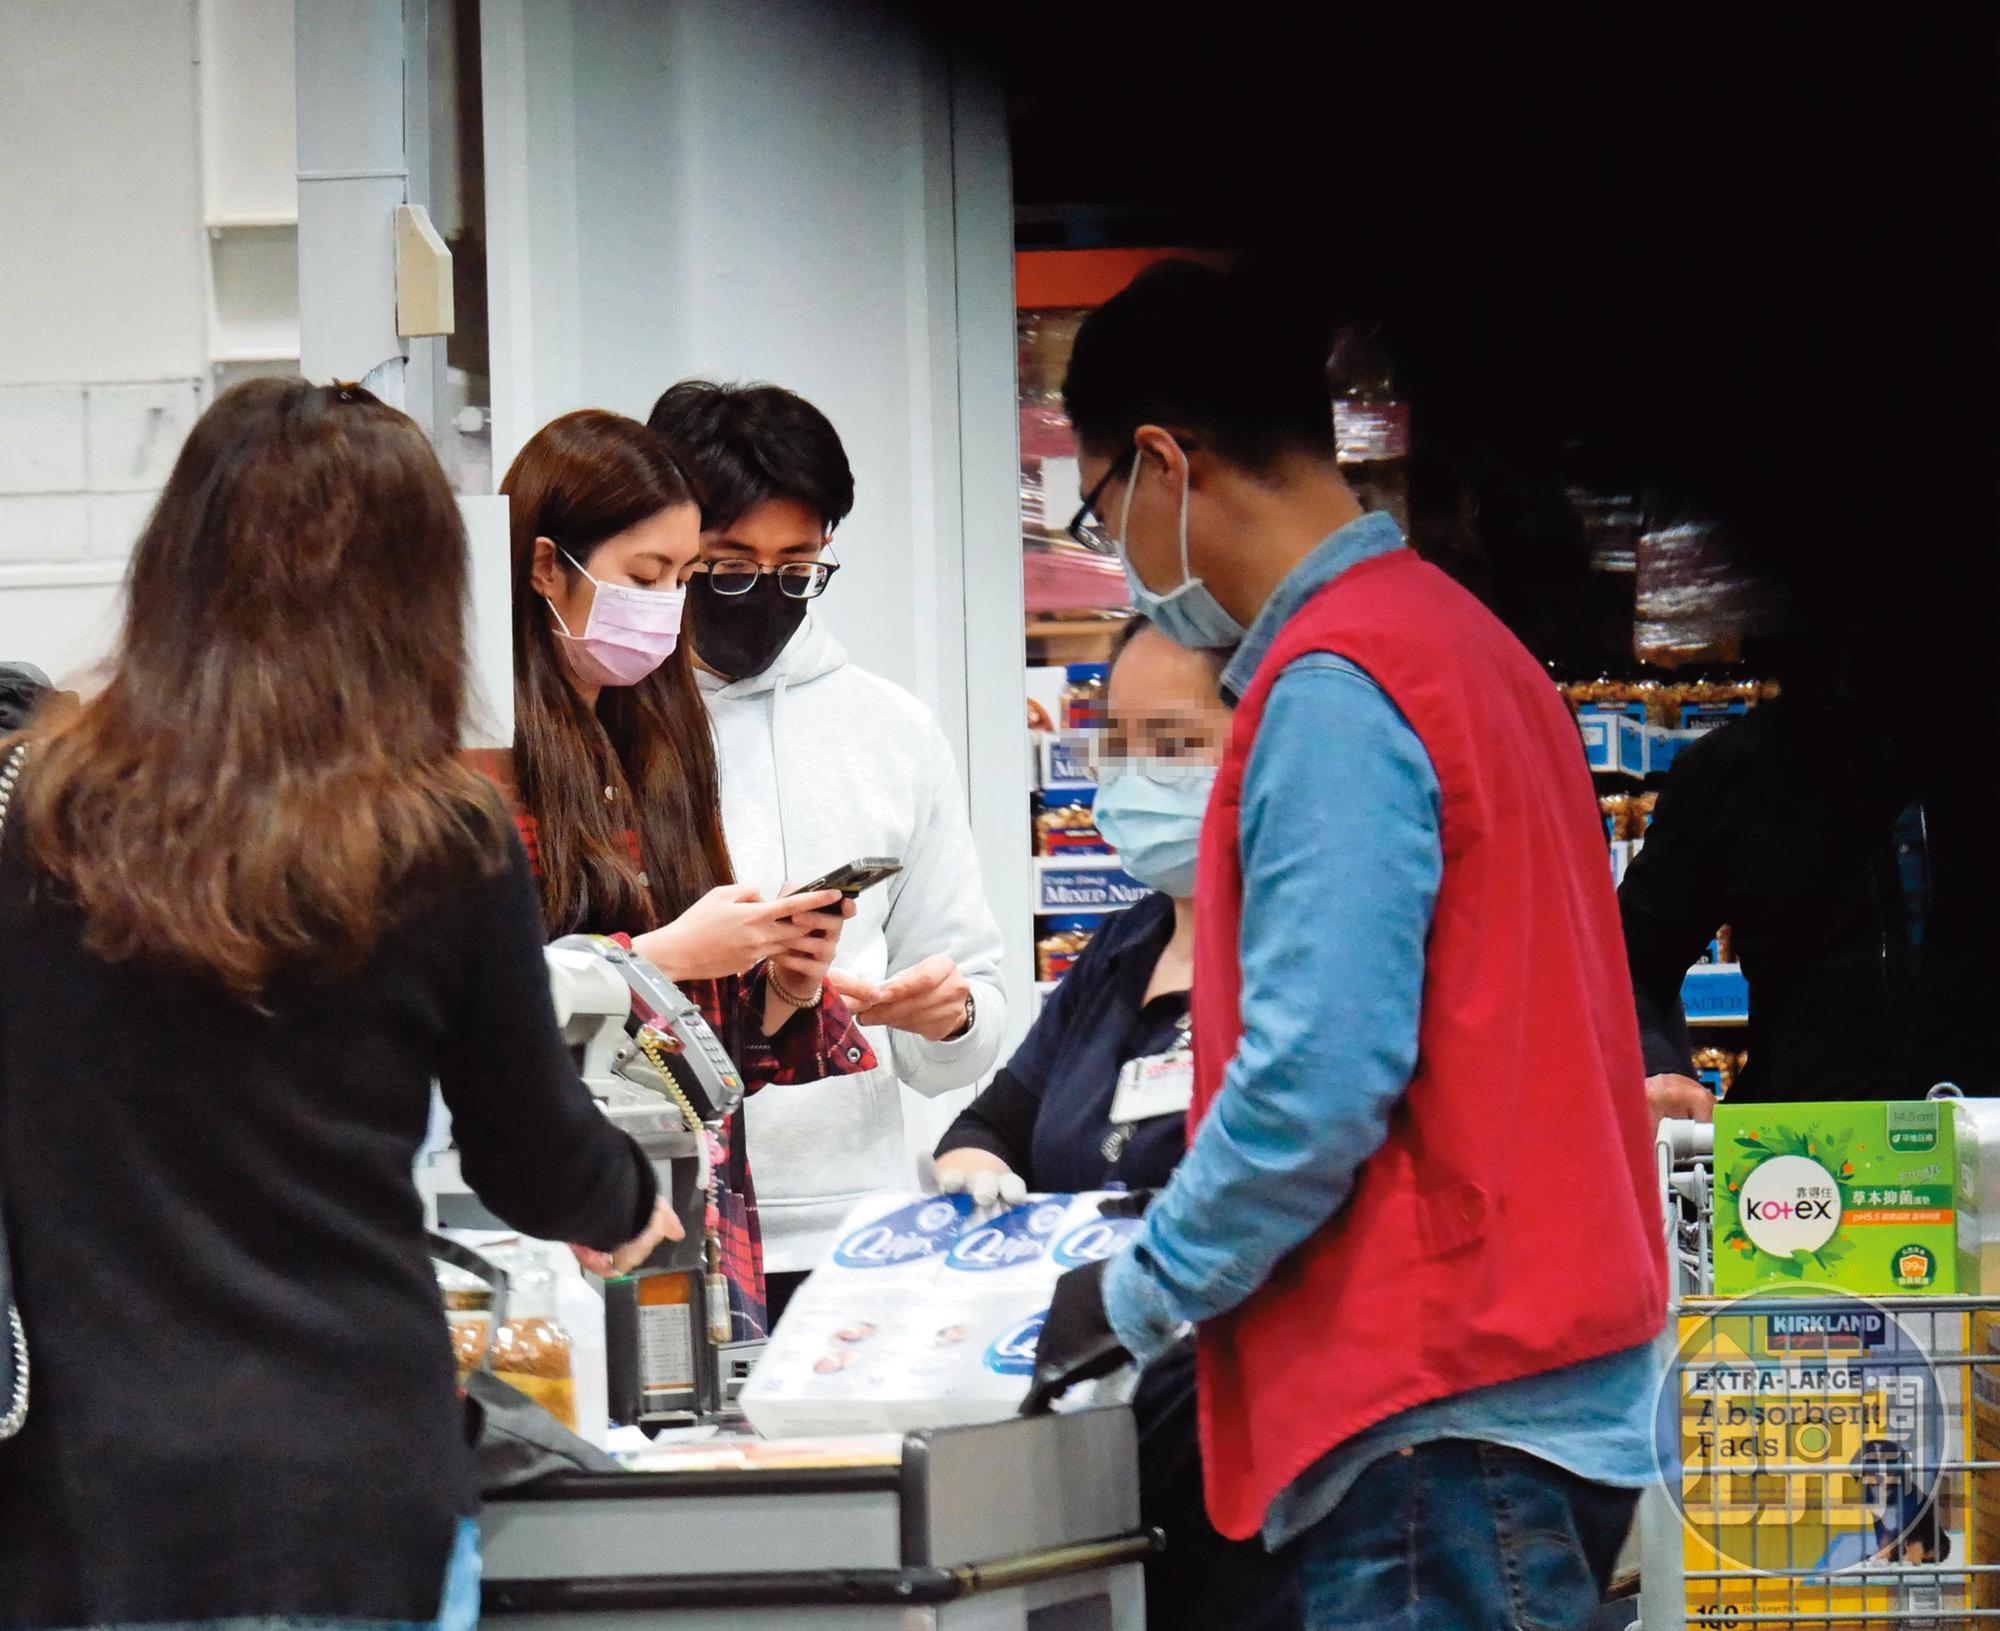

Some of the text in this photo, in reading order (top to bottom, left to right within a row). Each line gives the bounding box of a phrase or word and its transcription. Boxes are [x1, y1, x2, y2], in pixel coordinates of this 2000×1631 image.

[1796, 1186, 1832, 1199] 靠得住
[1747, 1197, 1832, 1220] kotex
[1774, 1315, 1881, 1333] KIRKLAND
[1695, 1370, 1863, 1391] EXTRA-LARGE
[1696, 1400, 1881, 1427] Absorbent
[1697, 1431, 1779, 1458] Pads
[1696, 1604, 1739, 1630] 100
